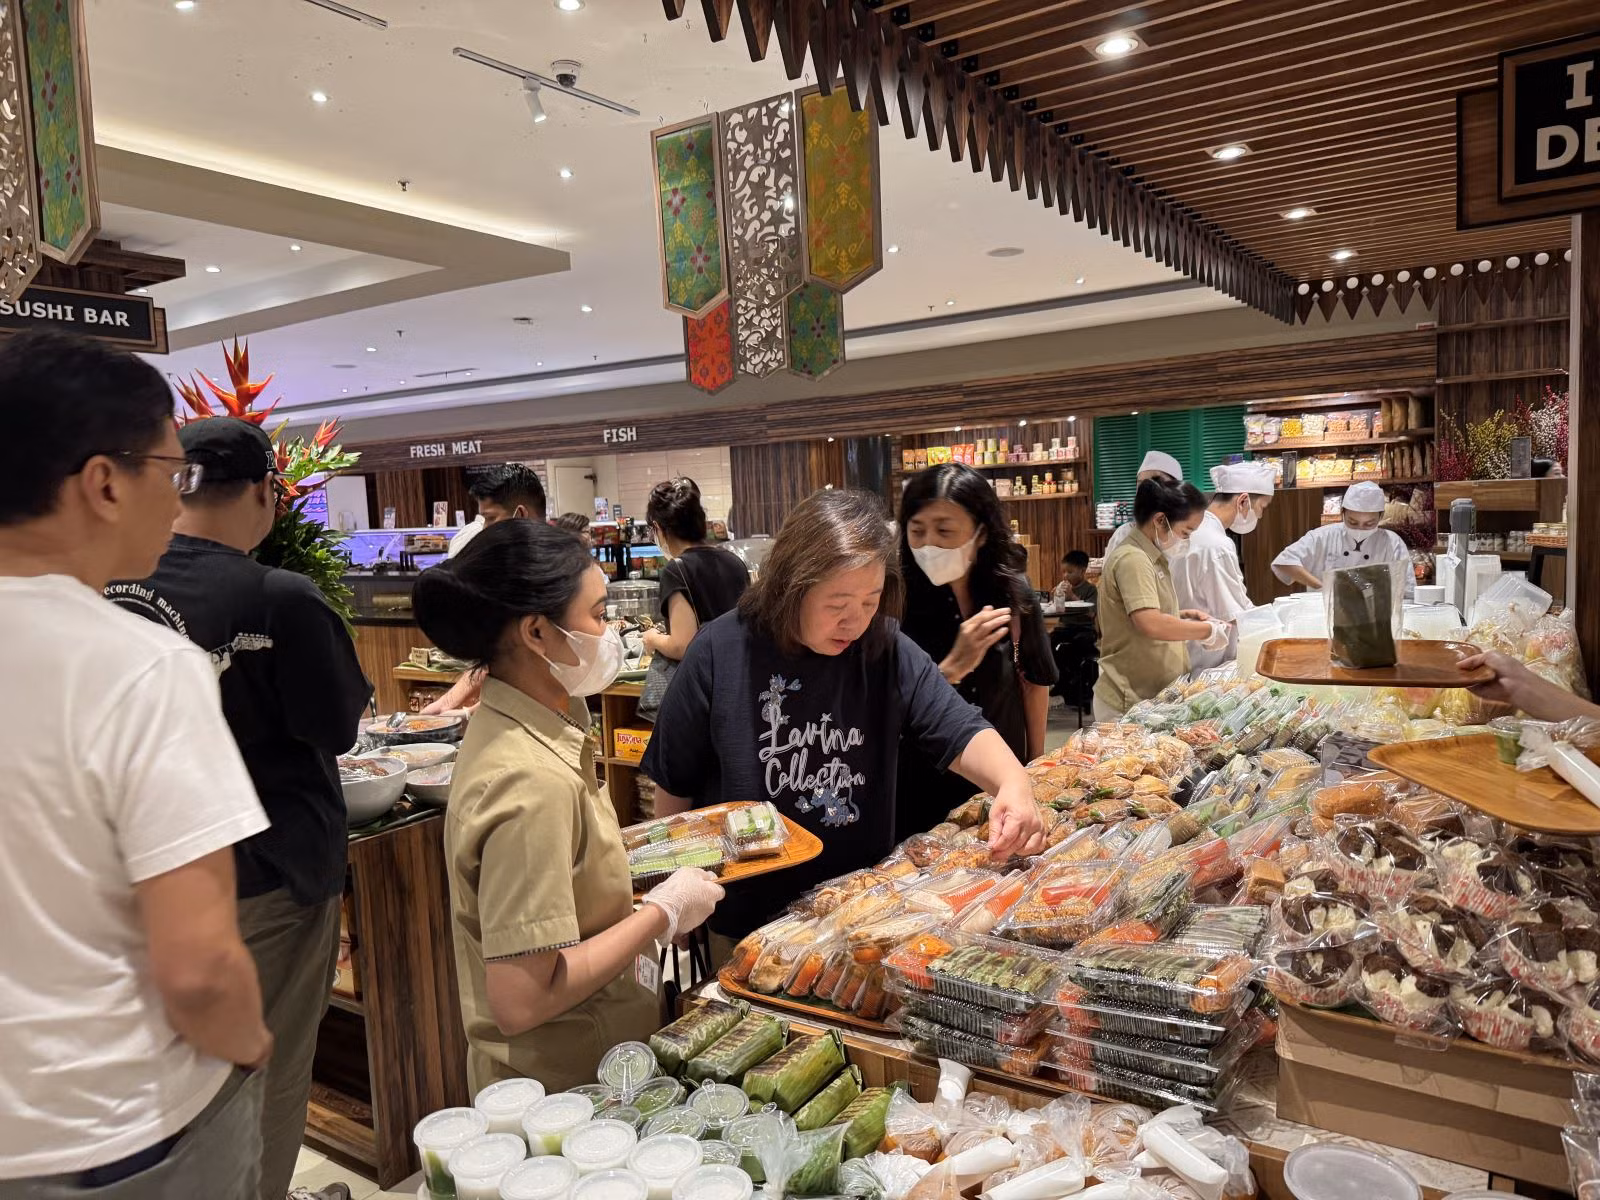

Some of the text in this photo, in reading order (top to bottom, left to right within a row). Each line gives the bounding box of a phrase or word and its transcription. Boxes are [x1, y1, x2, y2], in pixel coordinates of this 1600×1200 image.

[0, 299, 130, 327] SUSHI BAR
[603, 427, 637, 443] FISH
[410, 440, 482, 458] FRESH MEAT
[104, 583, 155, 601] ecording
[758, 704, 864, 762] Lavina
